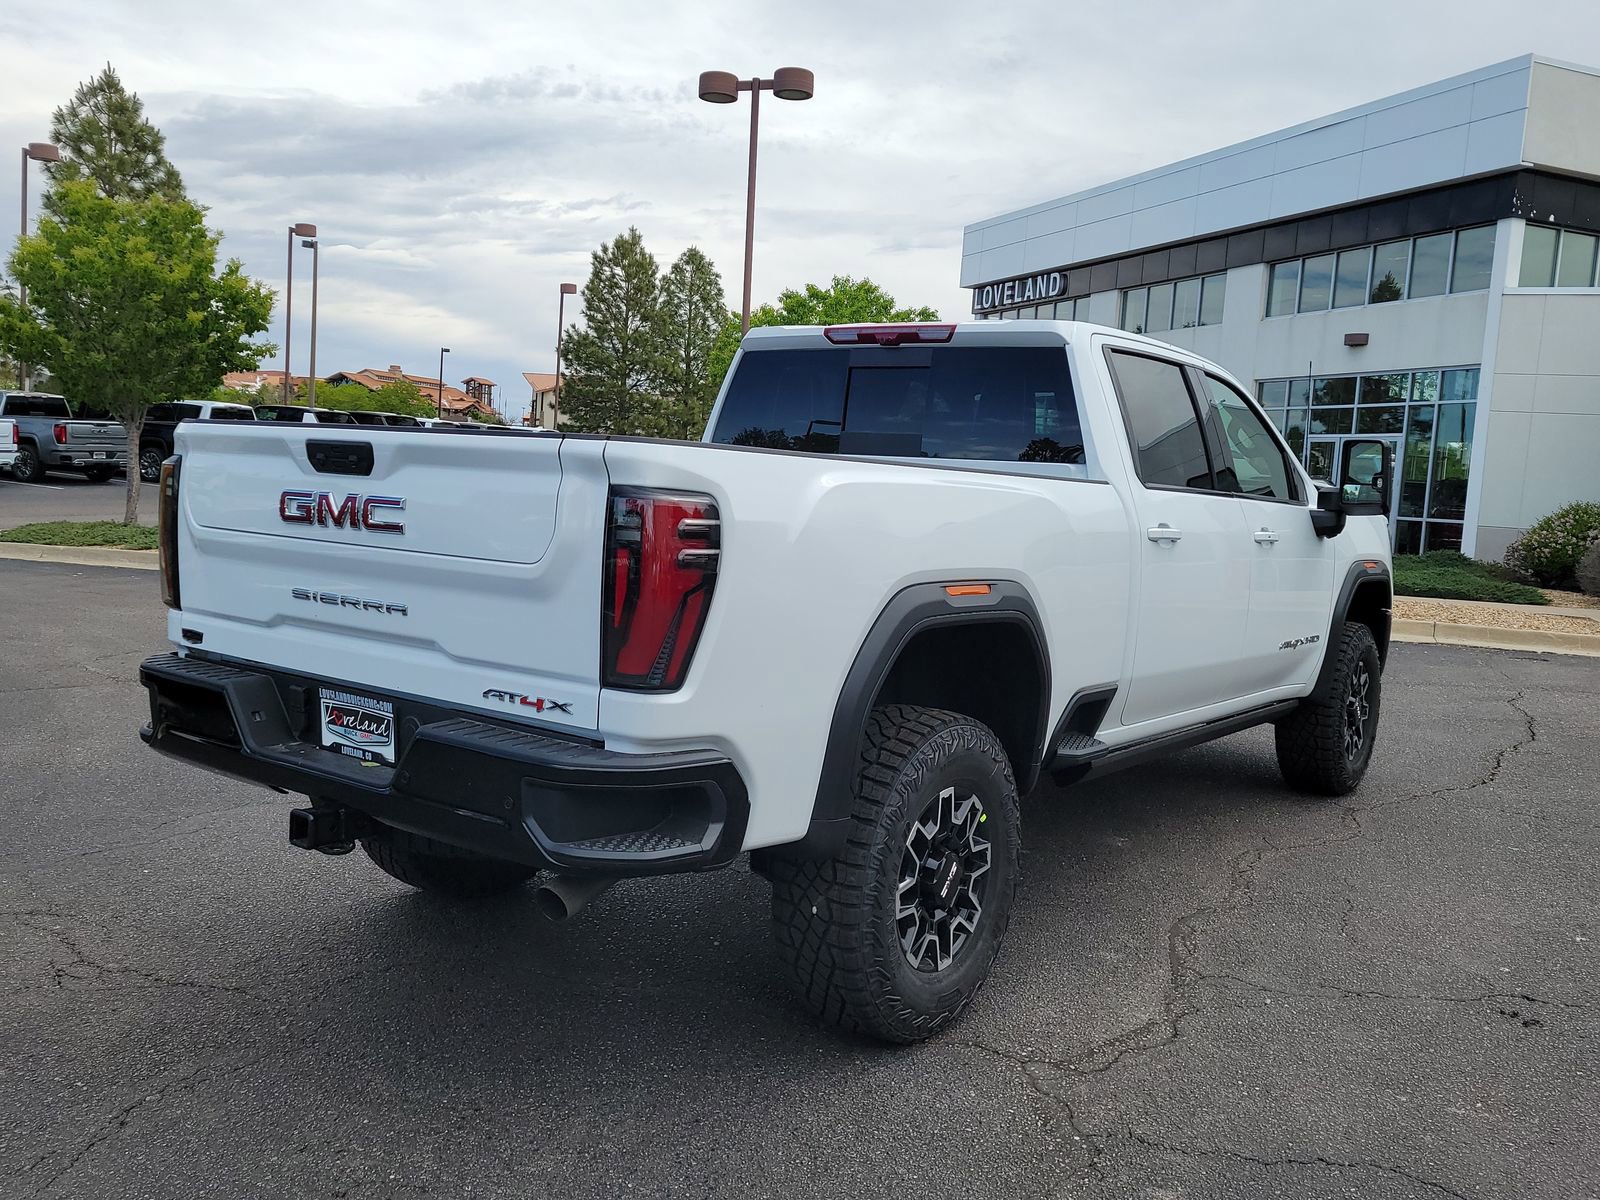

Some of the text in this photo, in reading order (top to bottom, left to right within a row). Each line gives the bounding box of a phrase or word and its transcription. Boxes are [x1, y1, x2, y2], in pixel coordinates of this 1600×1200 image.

[974, 272, 1061, 309] LOVELAND
[279, 488, 407, 535] GMC
[292, 588, 408, 616] SIERRA
[482, 689, 573, 715] AT4X
[344, 728, 358, 737] BUICK
